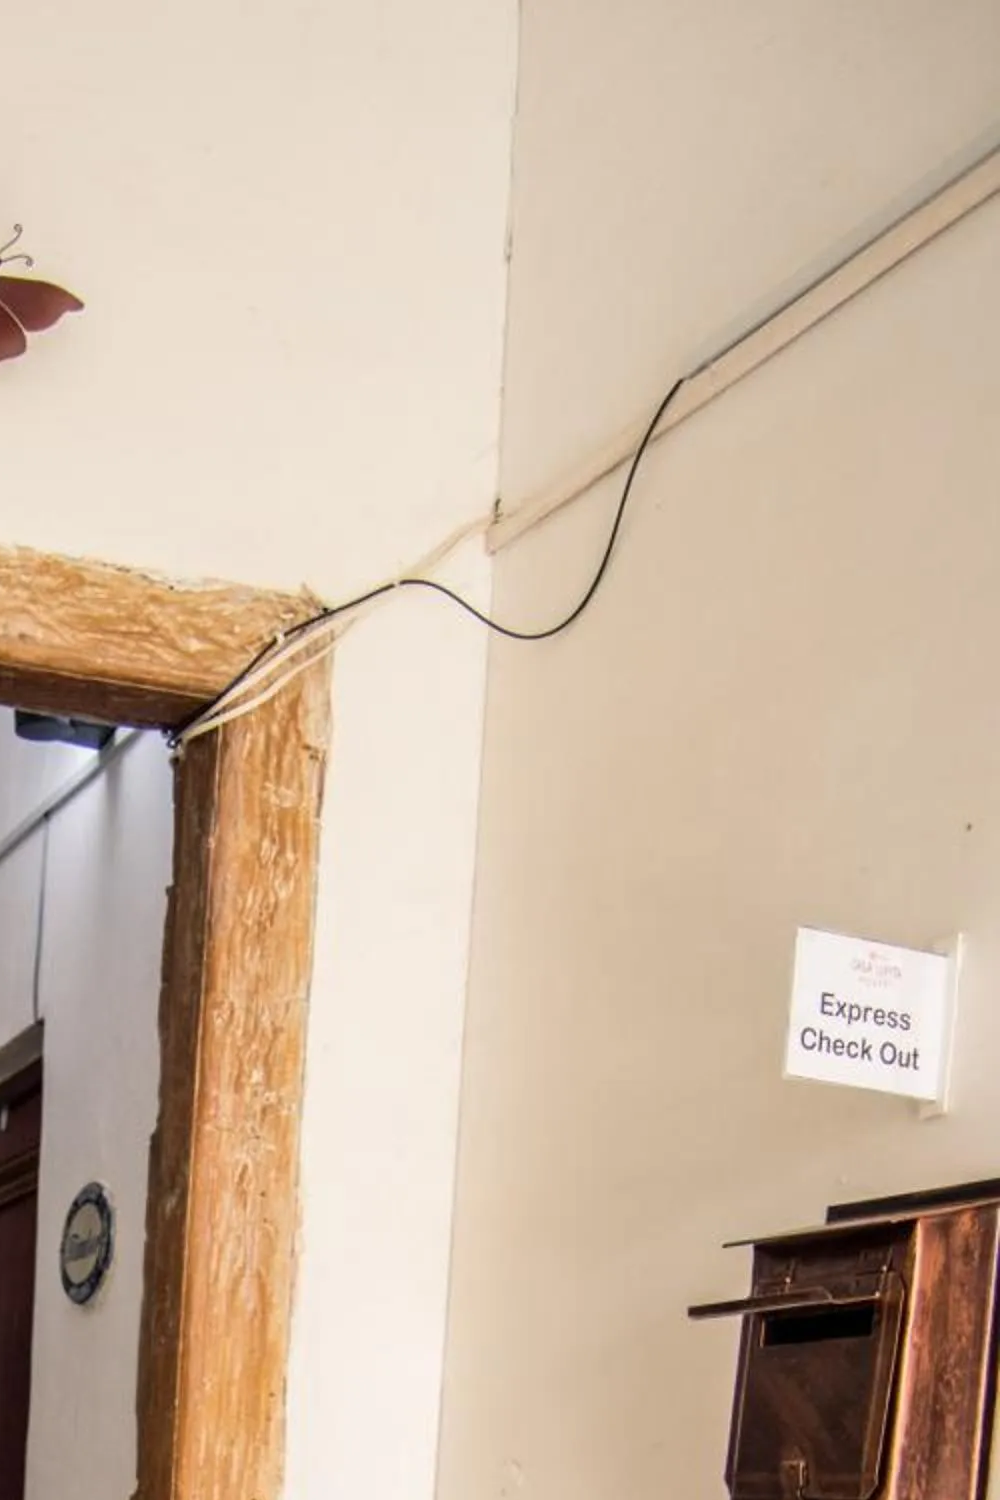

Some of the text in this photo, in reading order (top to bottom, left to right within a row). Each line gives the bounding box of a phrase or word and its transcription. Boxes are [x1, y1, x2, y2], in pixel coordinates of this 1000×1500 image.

[820, 992, 911, 1031] Express
[800, 1027, 920, 1071] Check Out
